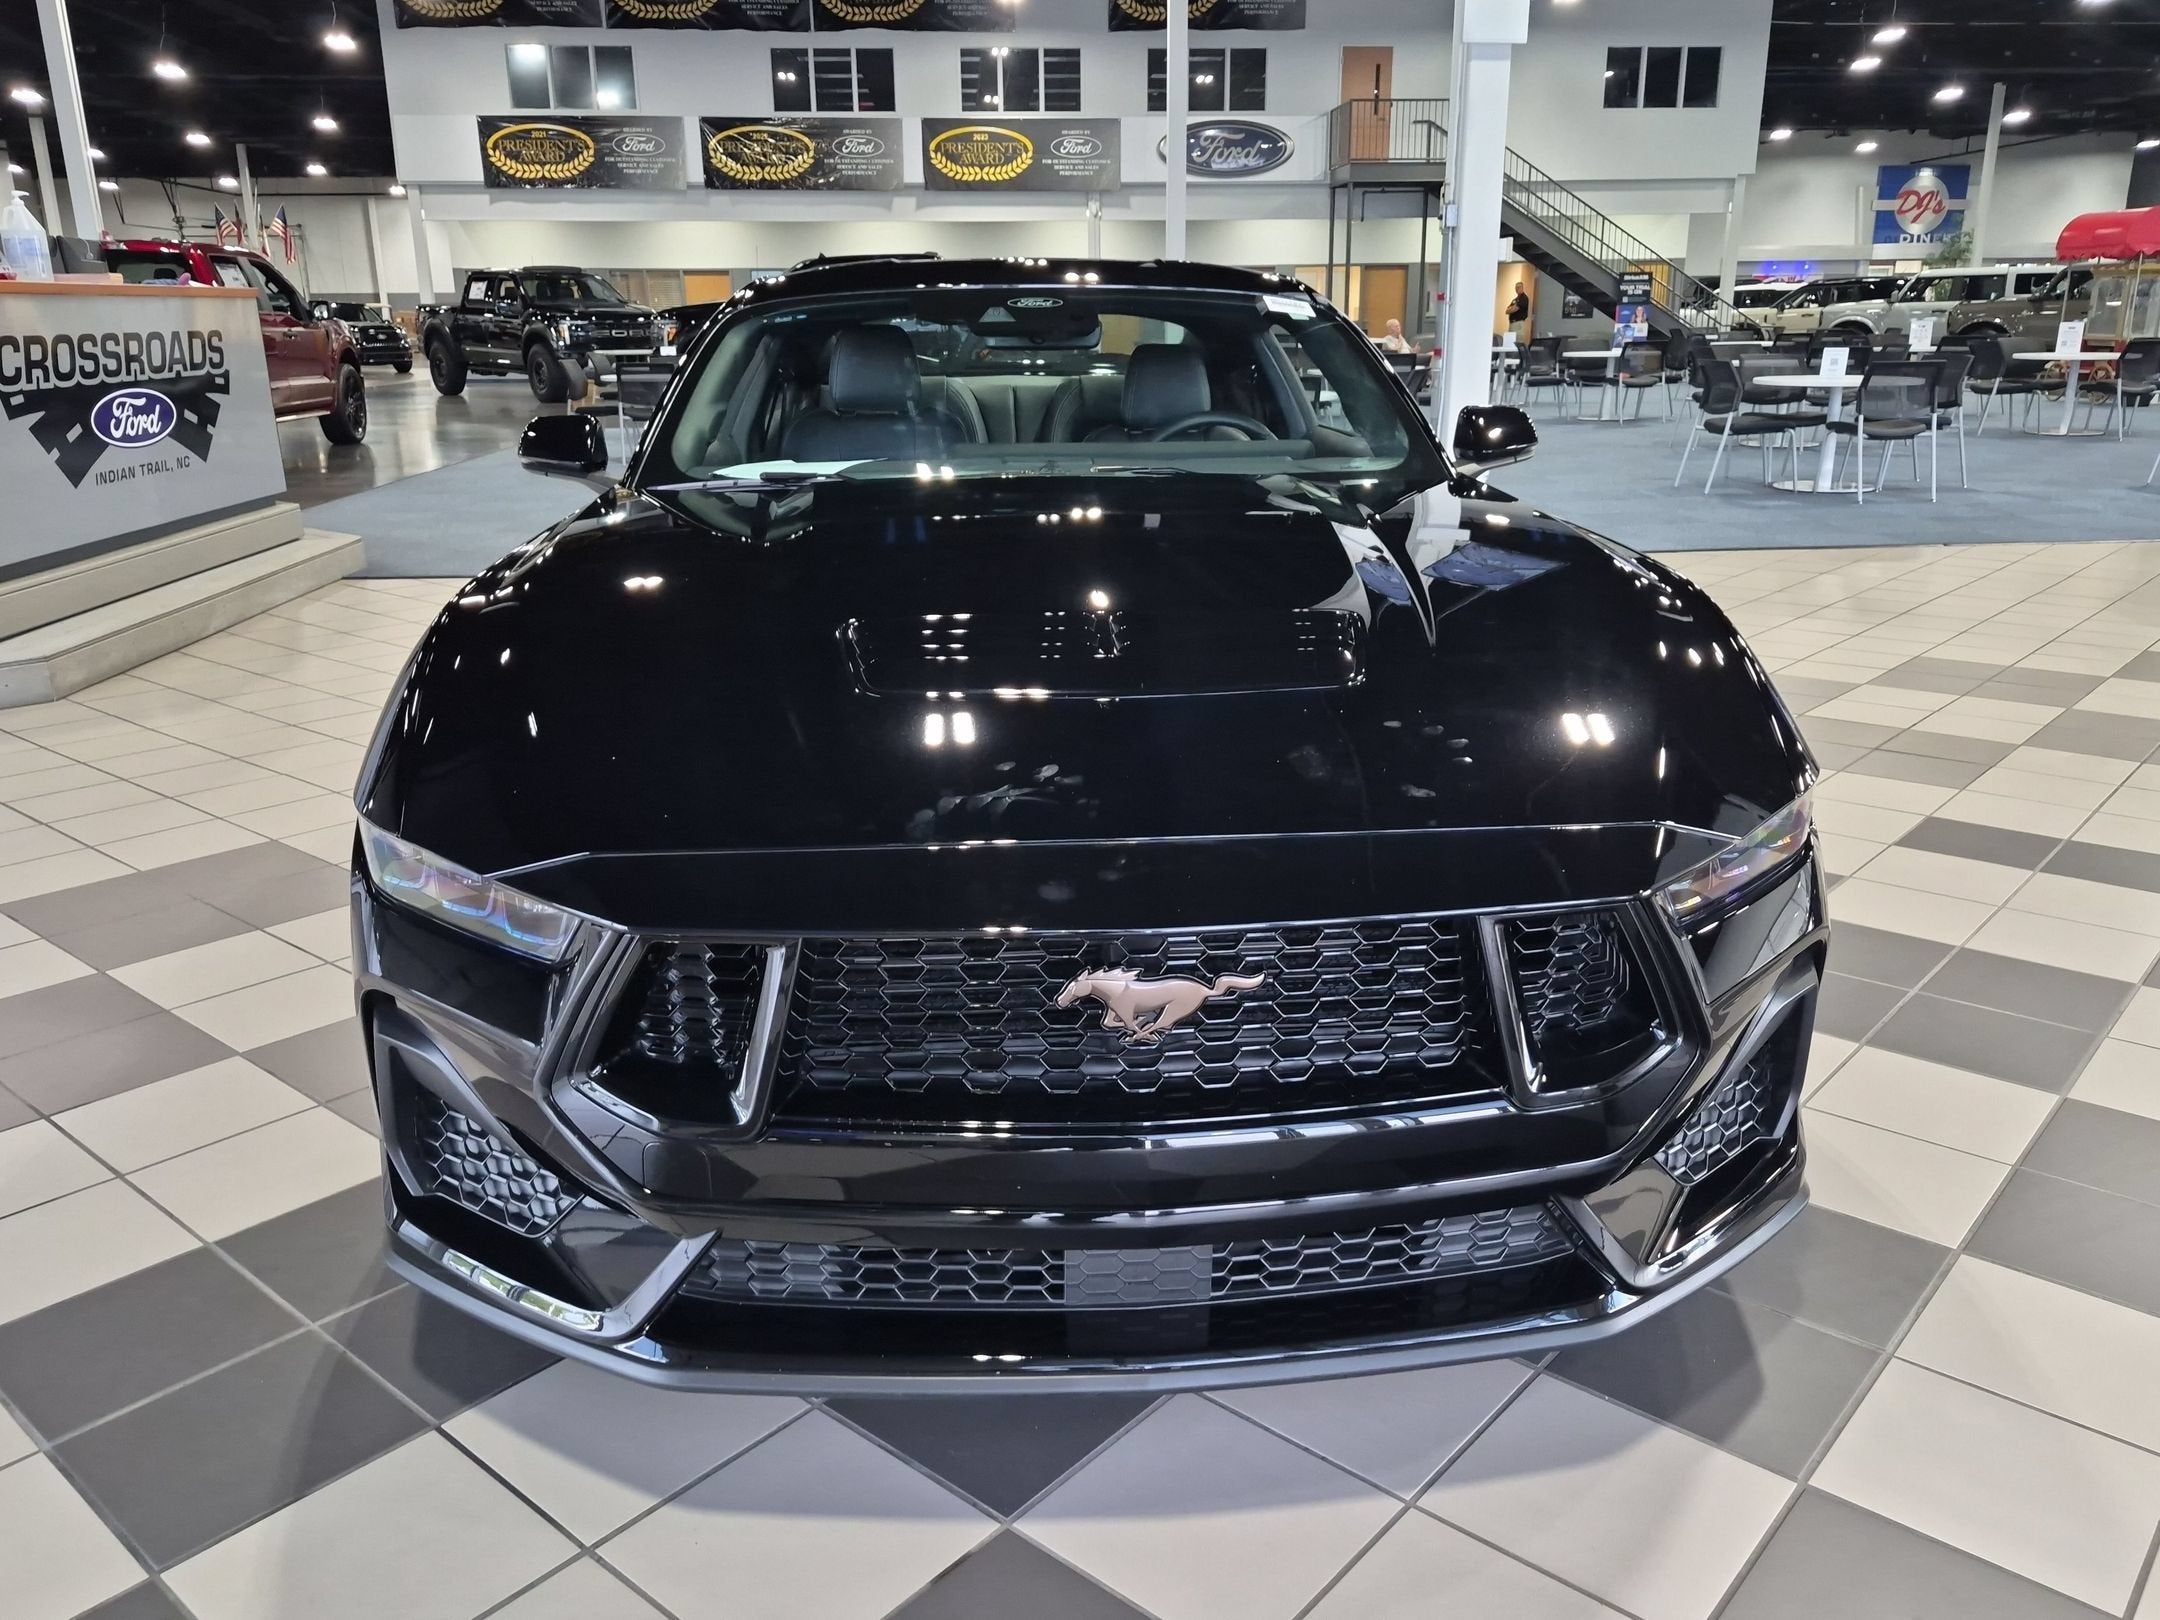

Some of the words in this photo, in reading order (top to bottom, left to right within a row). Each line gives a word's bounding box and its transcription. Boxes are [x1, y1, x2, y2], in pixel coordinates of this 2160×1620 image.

[498, 139, 585, 151] PRESIDENT'S
[622, 136, 655, 152] Ford
[842, 137, 875, 153] Ford
[941, 142, 1024, 154] PRESIDENT'S
[1060, 138, 1093, 154] Ford
[1192, 131, 1262, 163] Ford
[519, 150, 565, 162] AWARD
[959, 152, 1004, 164] AWARD
[1897, 189, 1946, 224] DJ's
[1017, 298, 1053, 306] Ford
[0, 330, 224, 387] CROSSROADS
[110, 397, 162, 439] Ford
[95, 467, 136, 486] INDIAN
[139, 460, 174, 477] TRAIL,
[176, 455, 191, 469] NC
